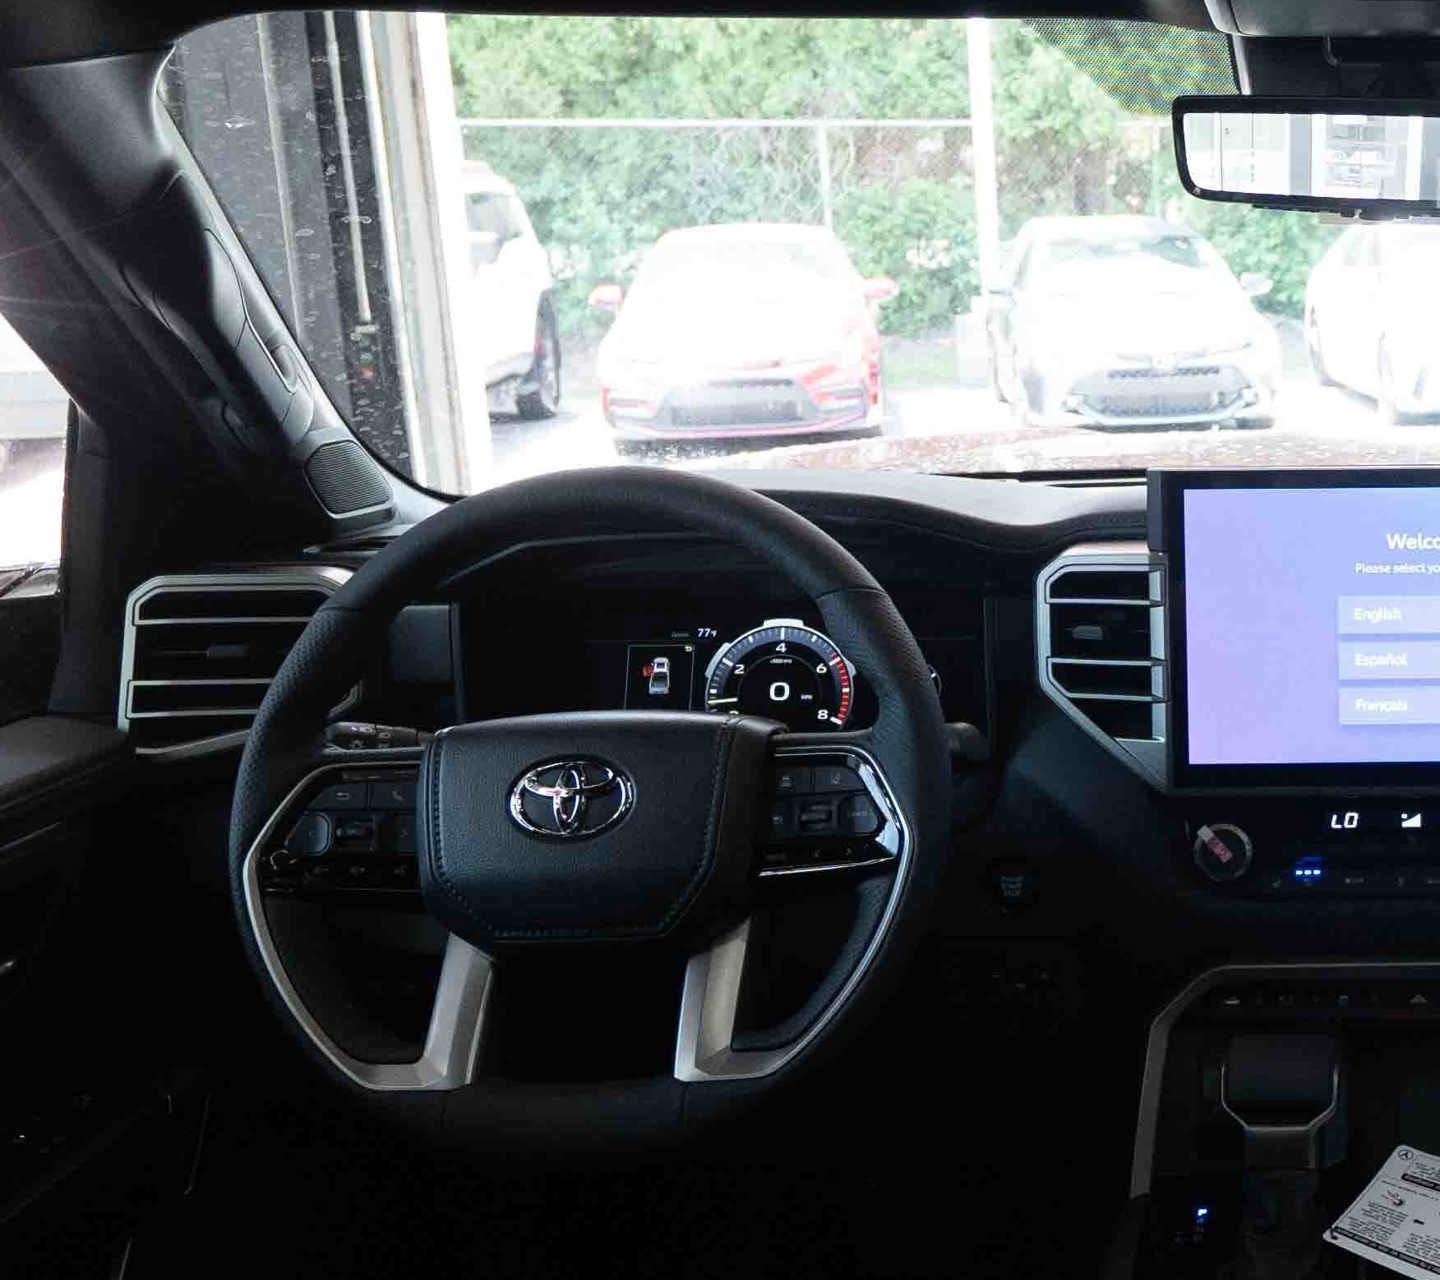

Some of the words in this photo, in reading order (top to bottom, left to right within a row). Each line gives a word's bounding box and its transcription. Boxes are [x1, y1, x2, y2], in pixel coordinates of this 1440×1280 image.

[1355, 562, 1391, 575] Please
[1393, 562, 1426, 574] select
[1353, 607, 1401, 624] English
[775, 642, 787, 654] 4
[1354, 651, 1408, 668] Español
[734, 664, 745, 675] 2
[816, 663, 827, 674] 6
[769, 681, 791, 702] 0
[1354, 697, 1408, 714] Français
[816, 709, 829, 720] 8
[1330, 811, 1360, 829] LO
